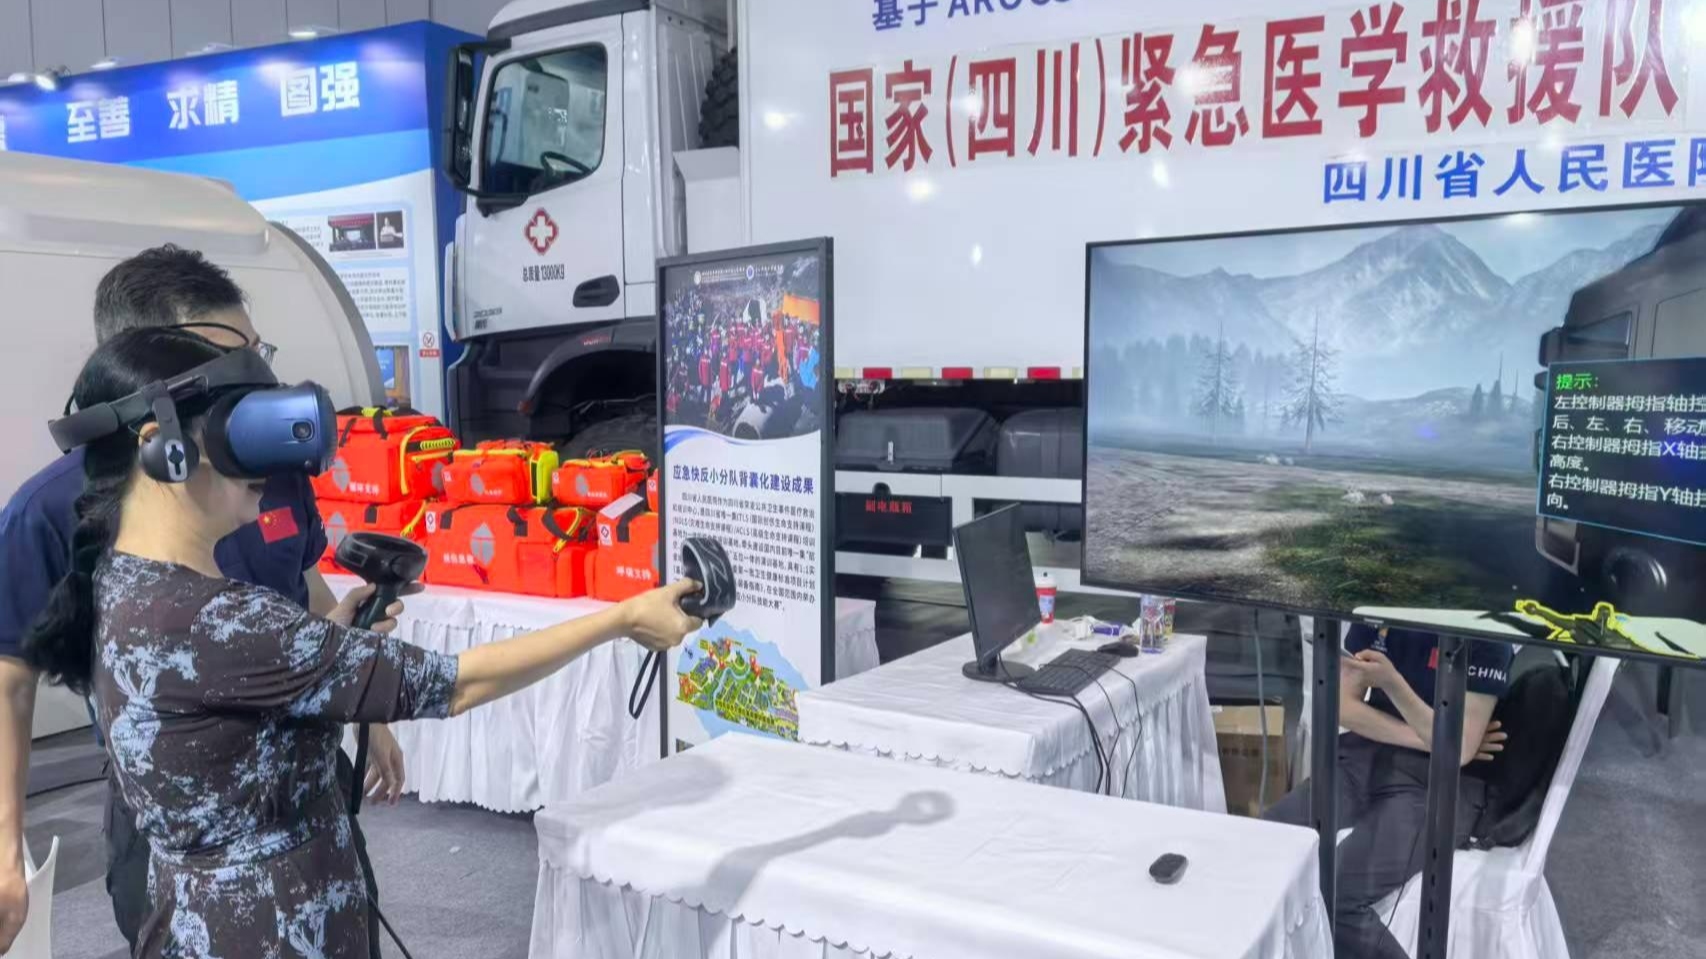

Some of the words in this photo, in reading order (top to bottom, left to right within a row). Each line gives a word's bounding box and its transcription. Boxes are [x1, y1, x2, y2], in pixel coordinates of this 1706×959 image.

[67, 97, 130, 143] 至善
[168, 79, 240, 130] 求精
[280, 61, 361, 117] 图强
[673, 465, 814, 494] 应急快反小分队背囊化建设成果
